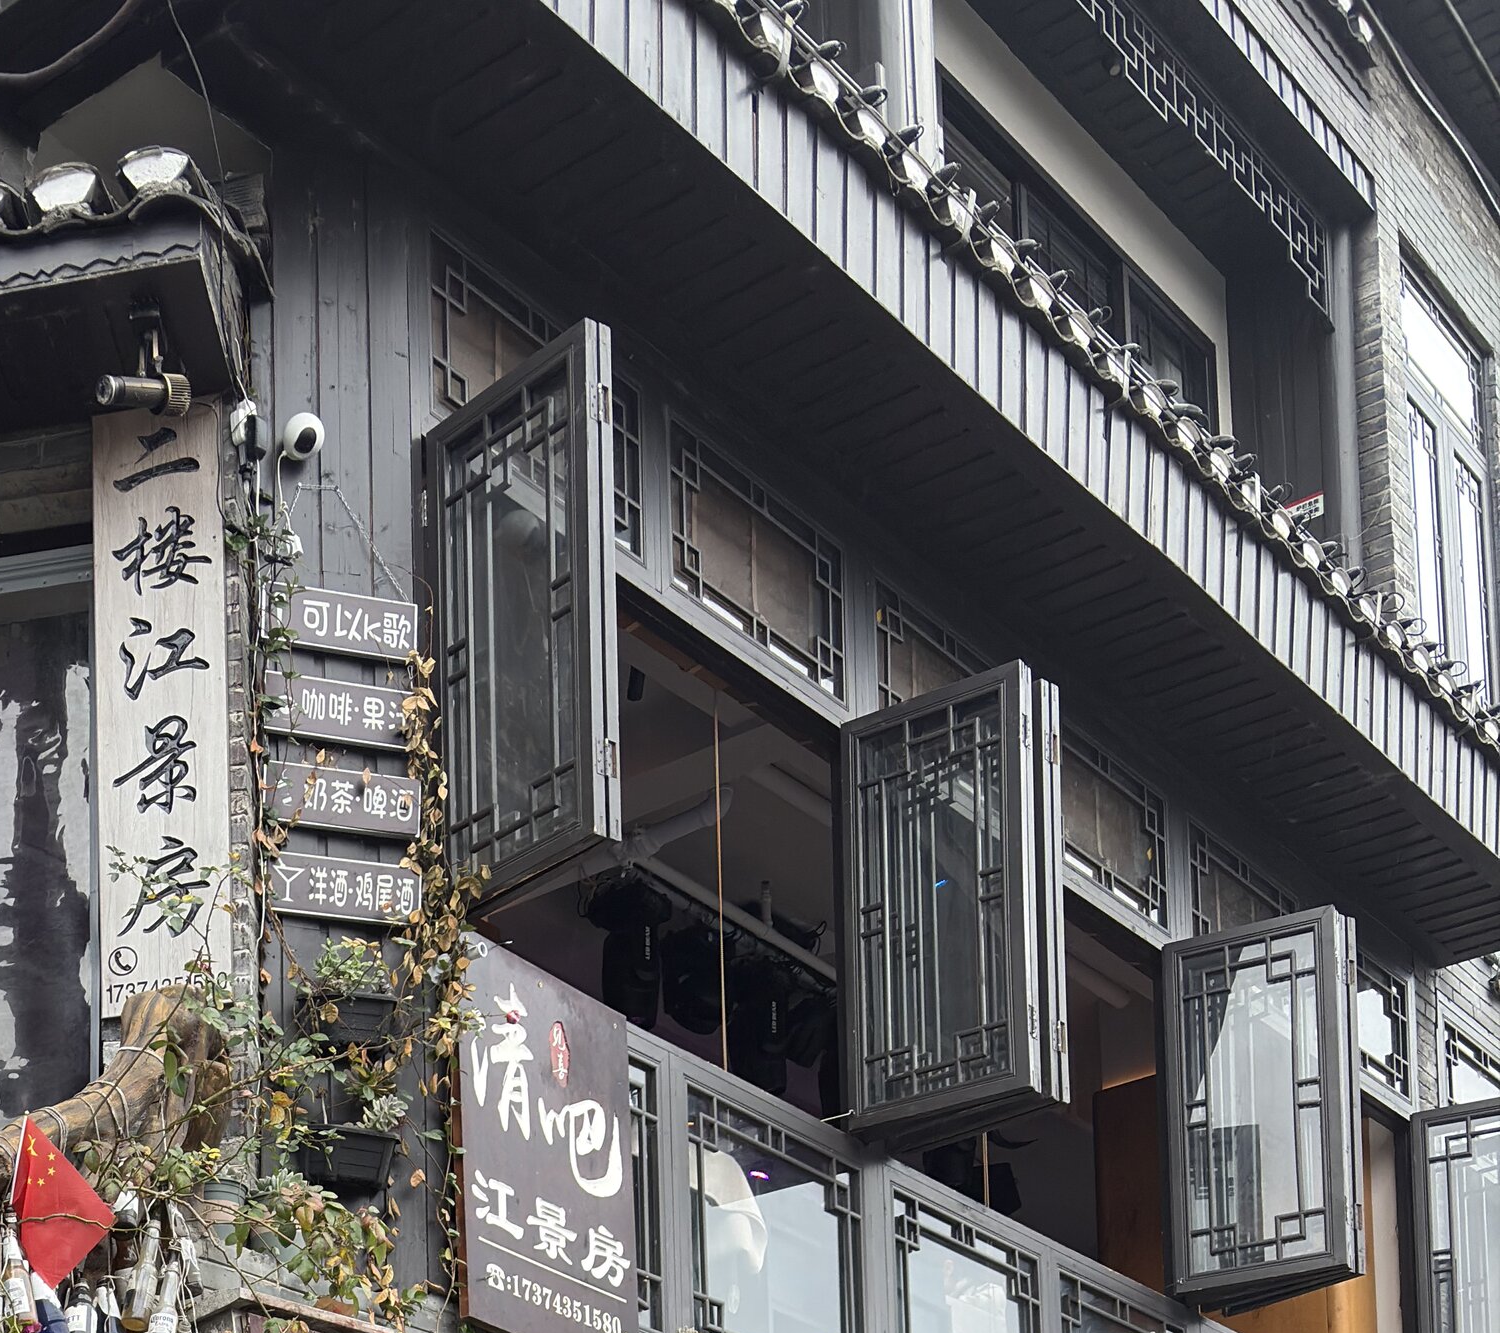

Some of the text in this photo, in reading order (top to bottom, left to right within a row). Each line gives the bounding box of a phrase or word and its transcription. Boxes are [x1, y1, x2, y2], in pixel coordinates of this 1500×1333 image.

[112, 427, 213, 938] 二楼江景房
[471, 1170, 631, 1288] 江景房
